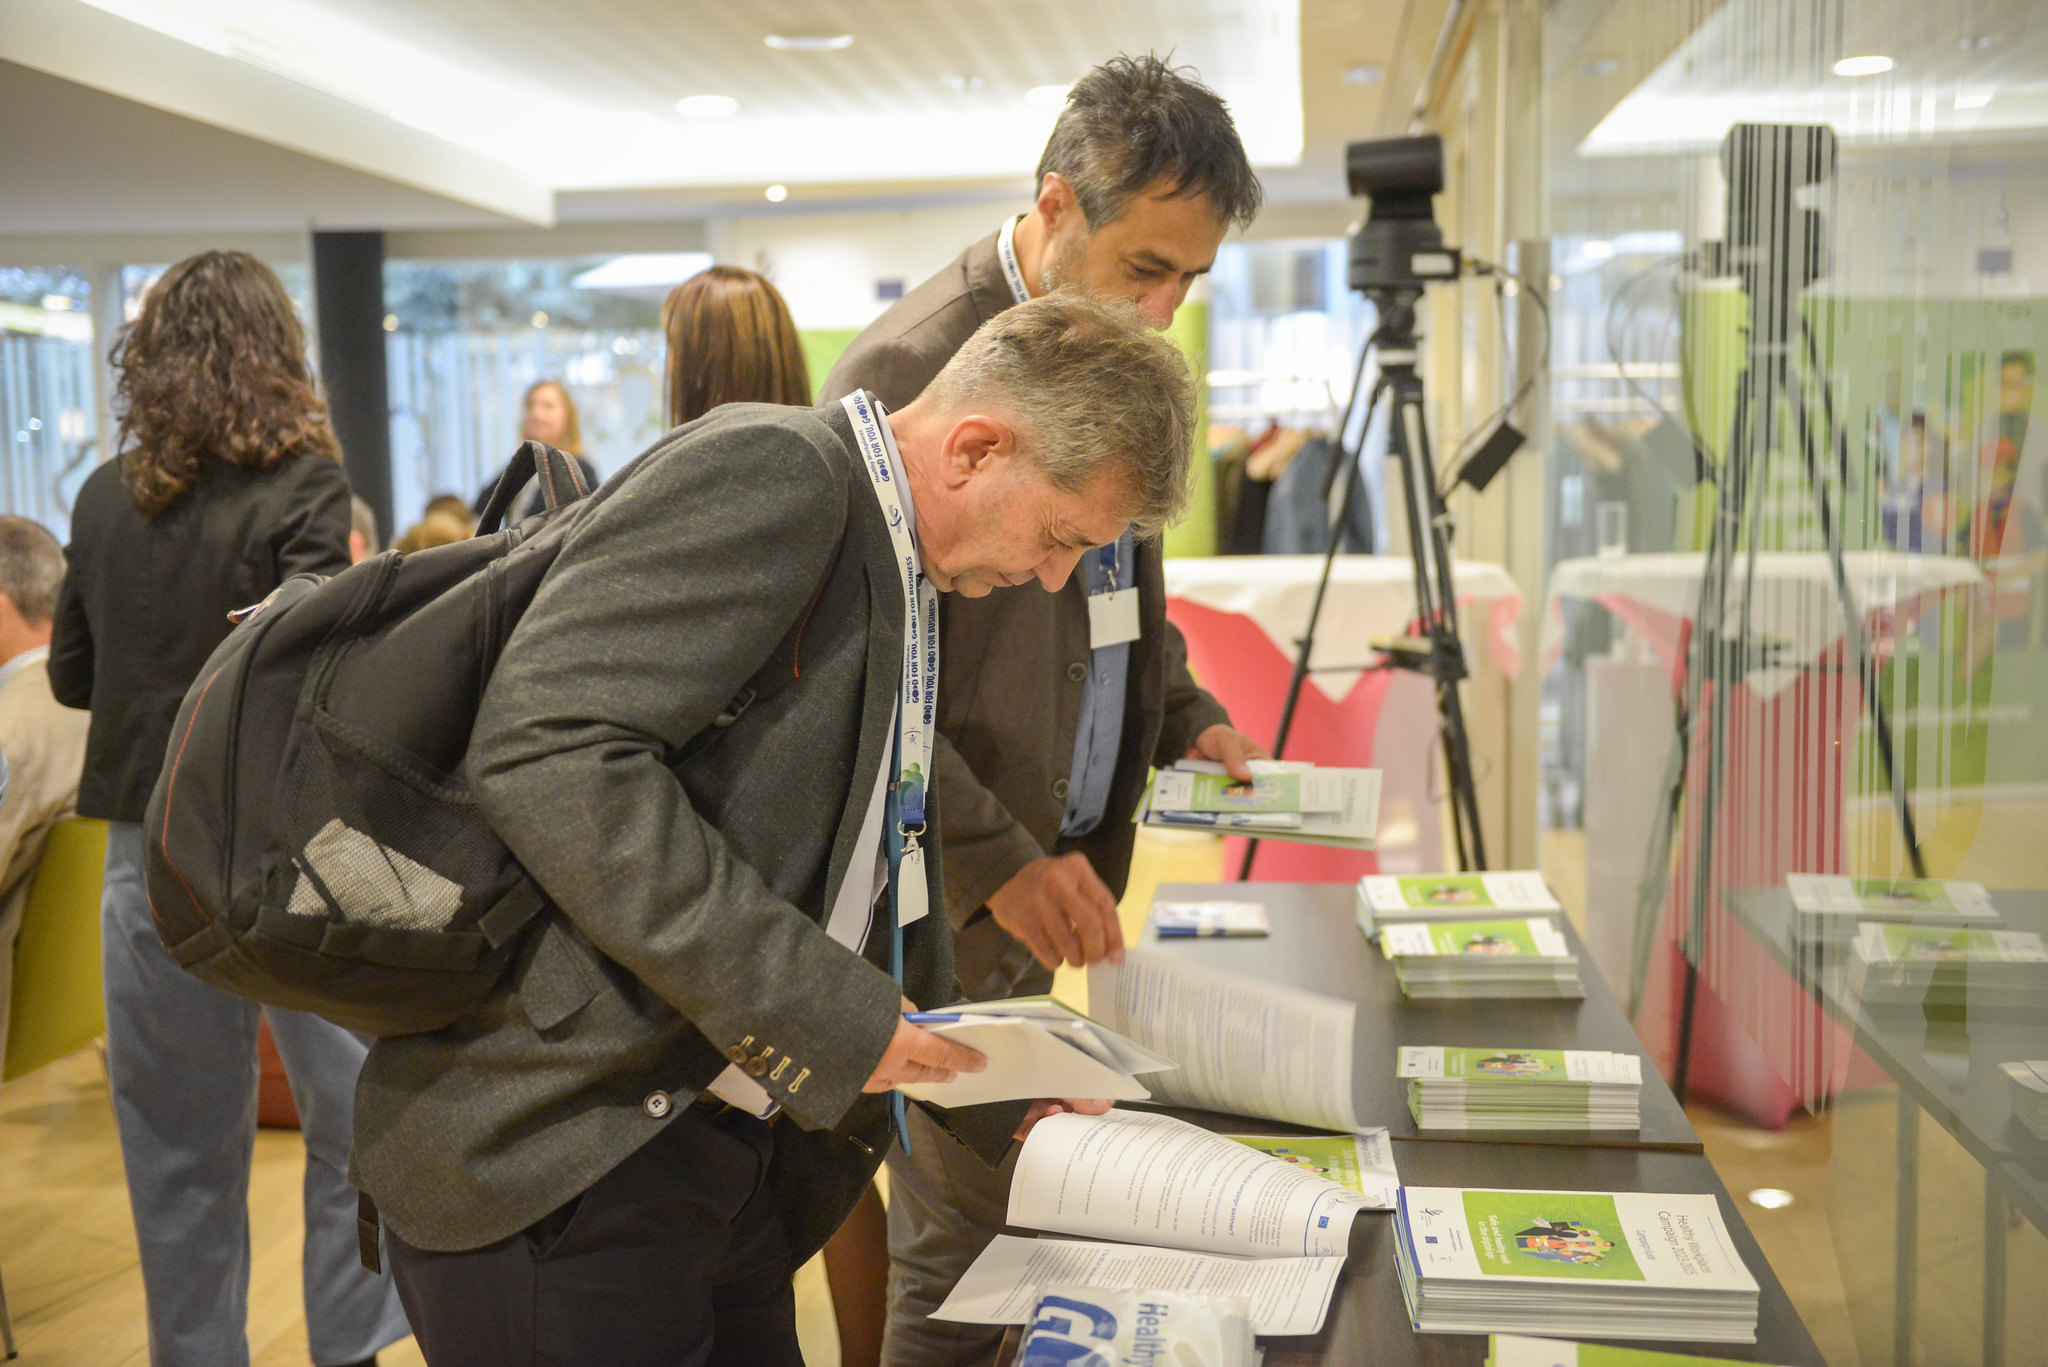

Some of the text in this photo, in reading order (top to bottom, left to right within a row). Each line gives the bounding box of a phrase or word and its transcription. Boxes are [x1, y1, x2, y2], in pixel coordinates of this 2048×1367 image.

[859, 429, 880, 483] Healthy Workplaces
[871, 442, 883, 458] FOR
[877, 458, 890, 482] GOOD
[905, 556, 914, 595] BUSINESS
[925, 690, 934, 704] FOR
[923, 705, 932, 725] GOOD
[1658, 1211, 1679, 1246] Campaign
[1676, 1214, 1695, 1240] Healthy
